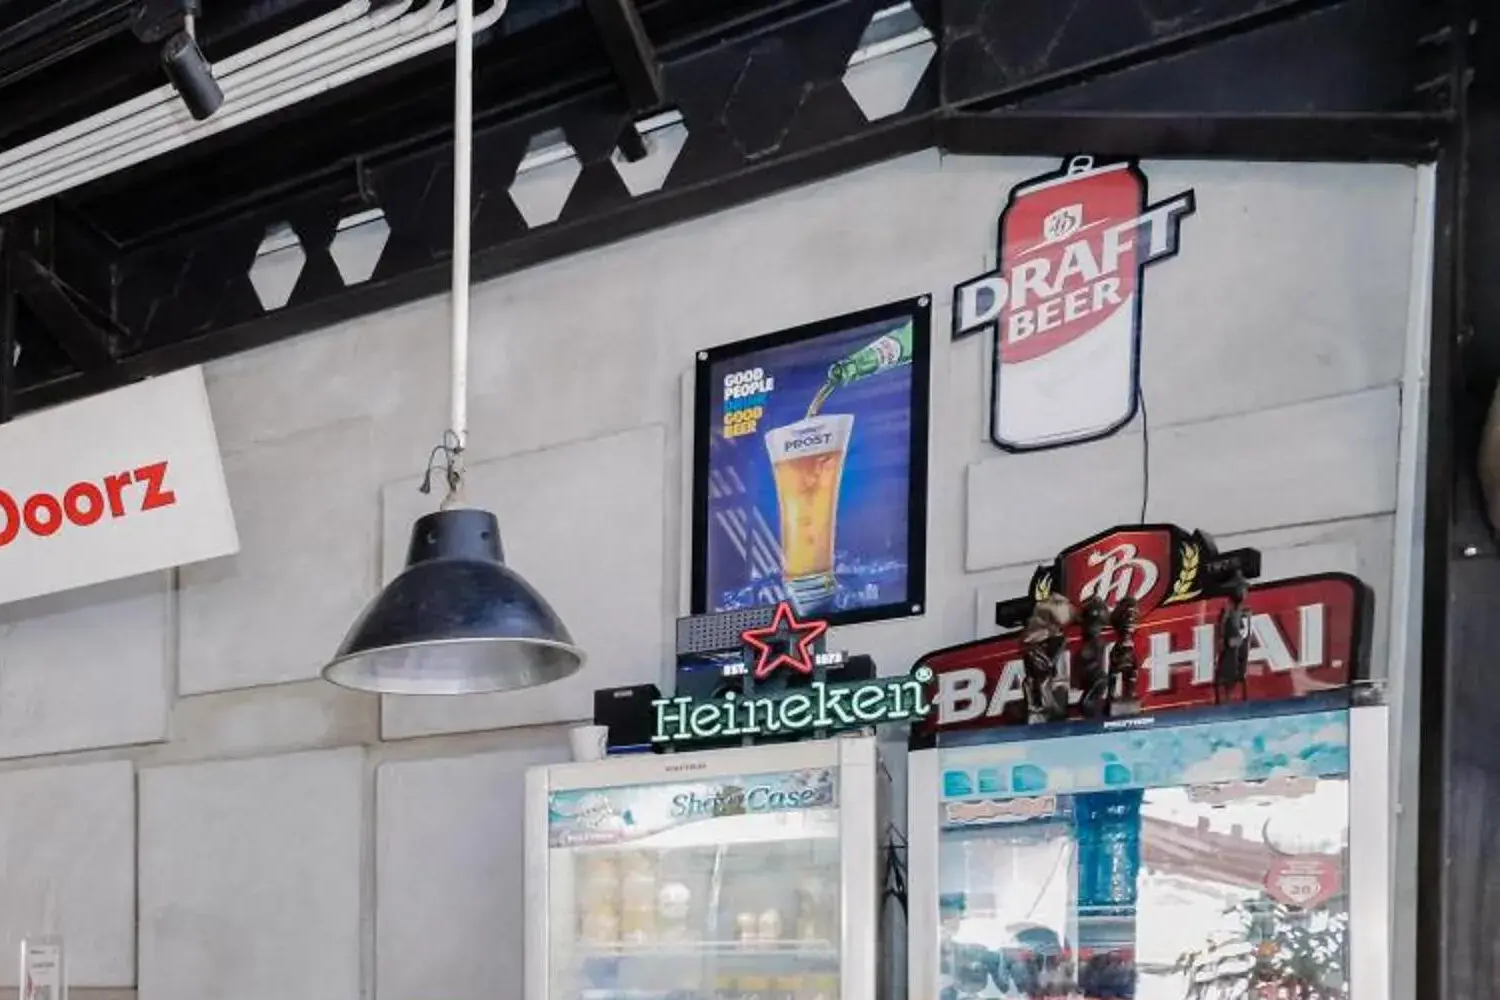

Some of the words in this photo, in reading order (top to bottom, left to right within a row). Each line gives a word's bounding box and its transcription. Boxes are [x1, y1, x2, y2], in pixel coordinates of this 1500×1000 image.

[960, 199, 1187, 333] DRAFT
[1007, 277, 1122, 345] BEER
[724, 367, 764, 387] GOOD
[724, 376, 775, 400] PEOPLE
[724, 405, 763, 425] GOOD
[784, 433, 832, 452] PROST
[651, 681, 932, 742] Heineken
[747, 785, 814, 811] Case
